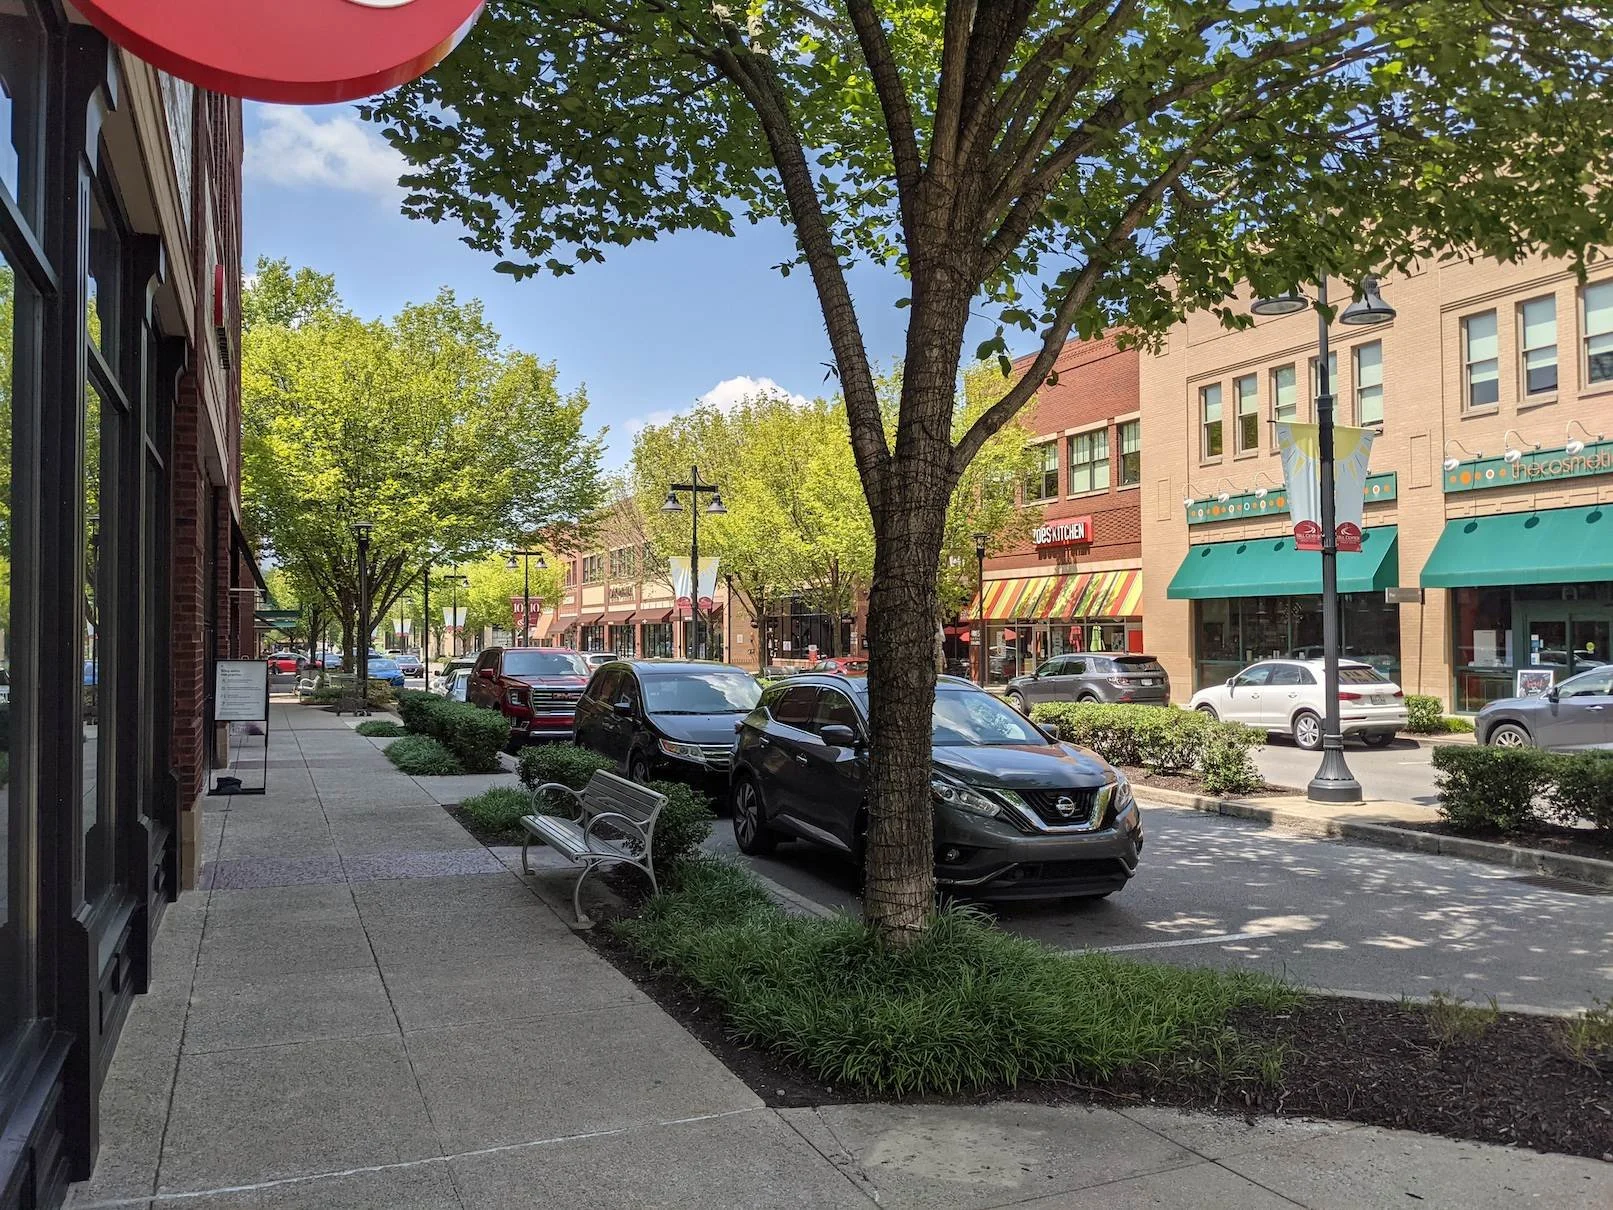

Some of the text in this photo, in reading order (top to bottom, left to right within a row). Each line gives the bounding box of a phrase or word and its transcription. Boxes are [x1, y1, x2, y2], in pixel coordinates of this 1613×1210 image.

[1511, 447, 1613, 479] thecosmeti
[1052, 522, 1085, 542] KITCHEN
[513, 603, 524, 613] 10
[530, 603, 540, 613] 10
